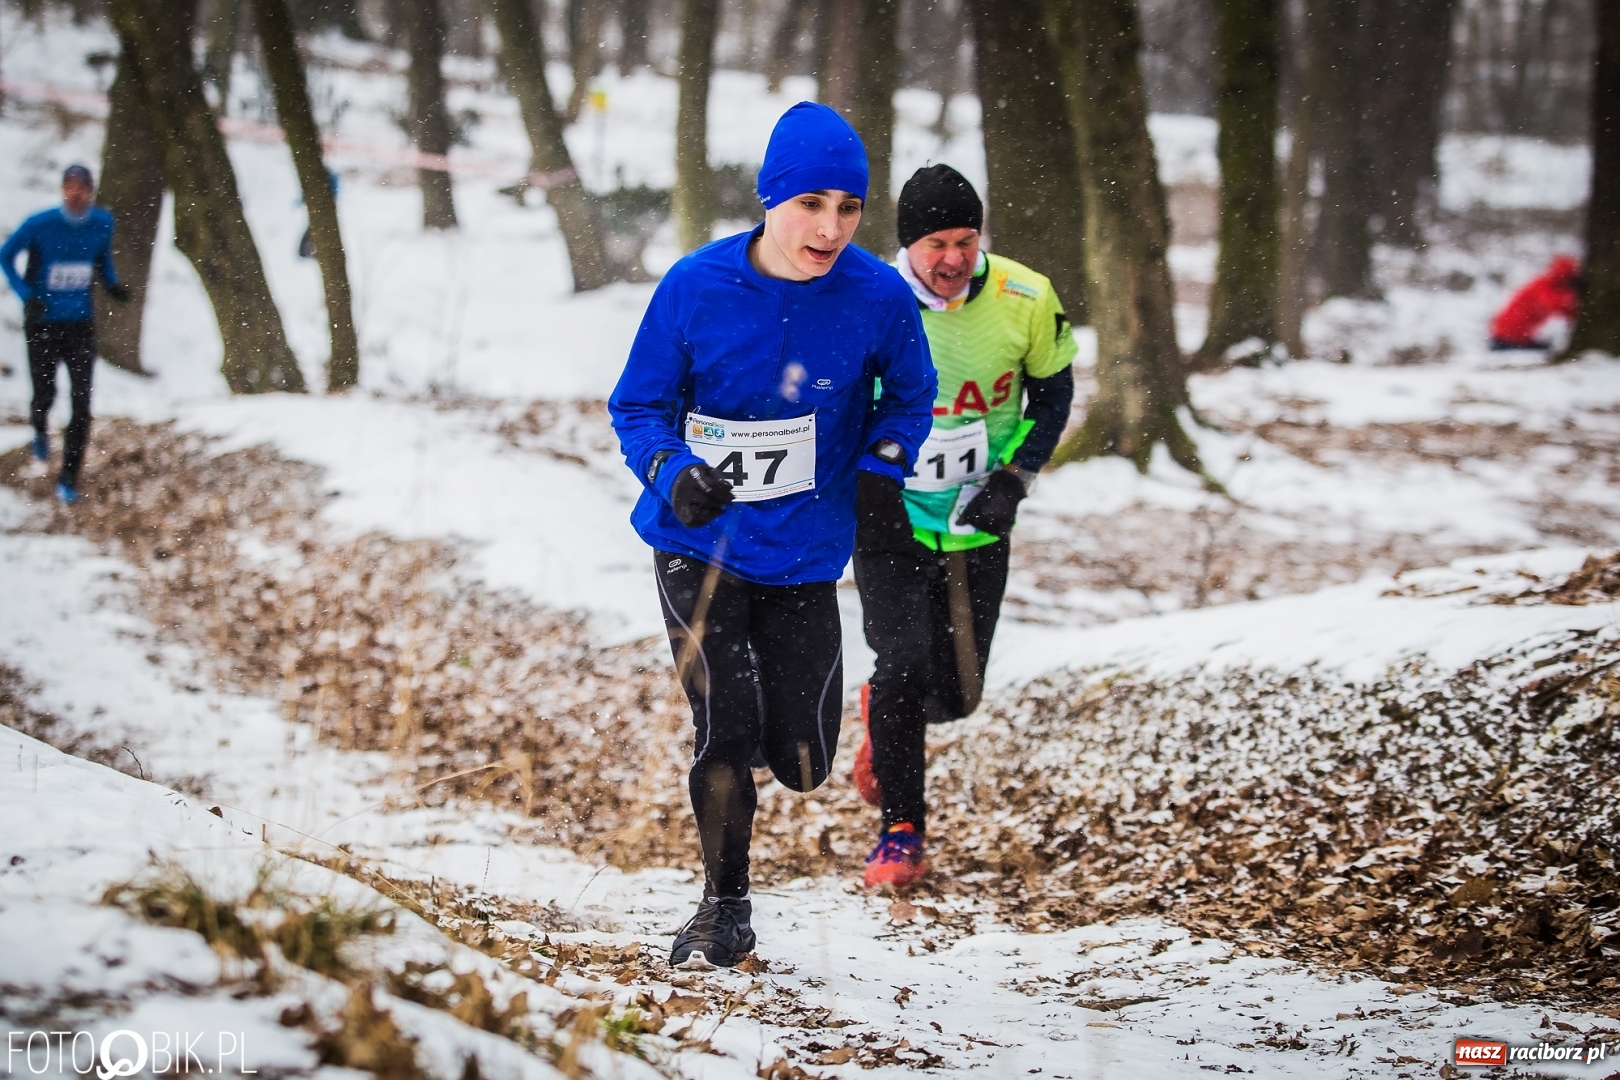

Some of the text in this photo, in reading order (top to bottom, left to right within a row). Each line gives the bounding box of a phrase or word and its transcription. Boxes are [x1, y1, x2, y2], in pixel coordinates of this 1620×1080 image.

[730, 425, 810, 439] www.personalbest.pl
[714, 449, 788, 487] 47
[912, 448, 977, 479] 11
